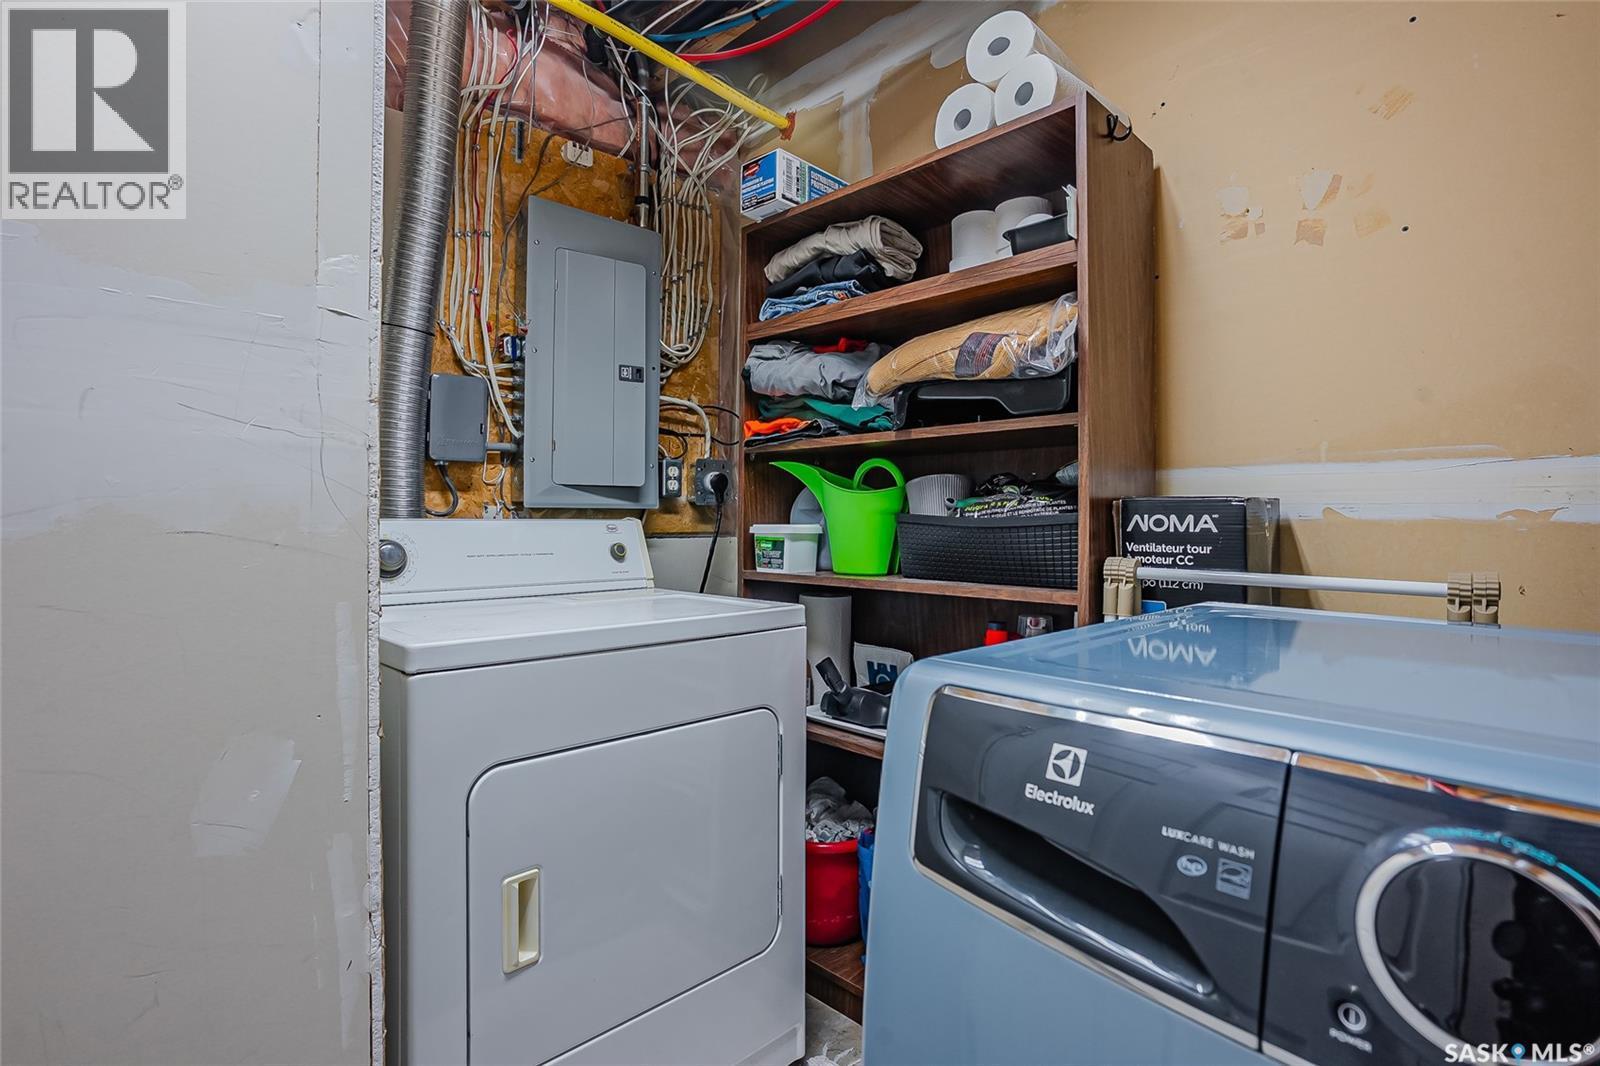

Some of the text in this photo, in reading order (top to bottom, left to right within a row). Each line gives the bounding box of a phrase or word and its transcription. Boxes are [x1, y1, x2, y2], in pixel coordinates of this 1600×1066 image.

[1126, 542, 1213, 555] Ventilateur tour
[1176, 555, 1195, 566] CC
[1024, 783, 1095, 816] Electrolux
[1161, 825, 1256, 860] LUXCARE WASH
